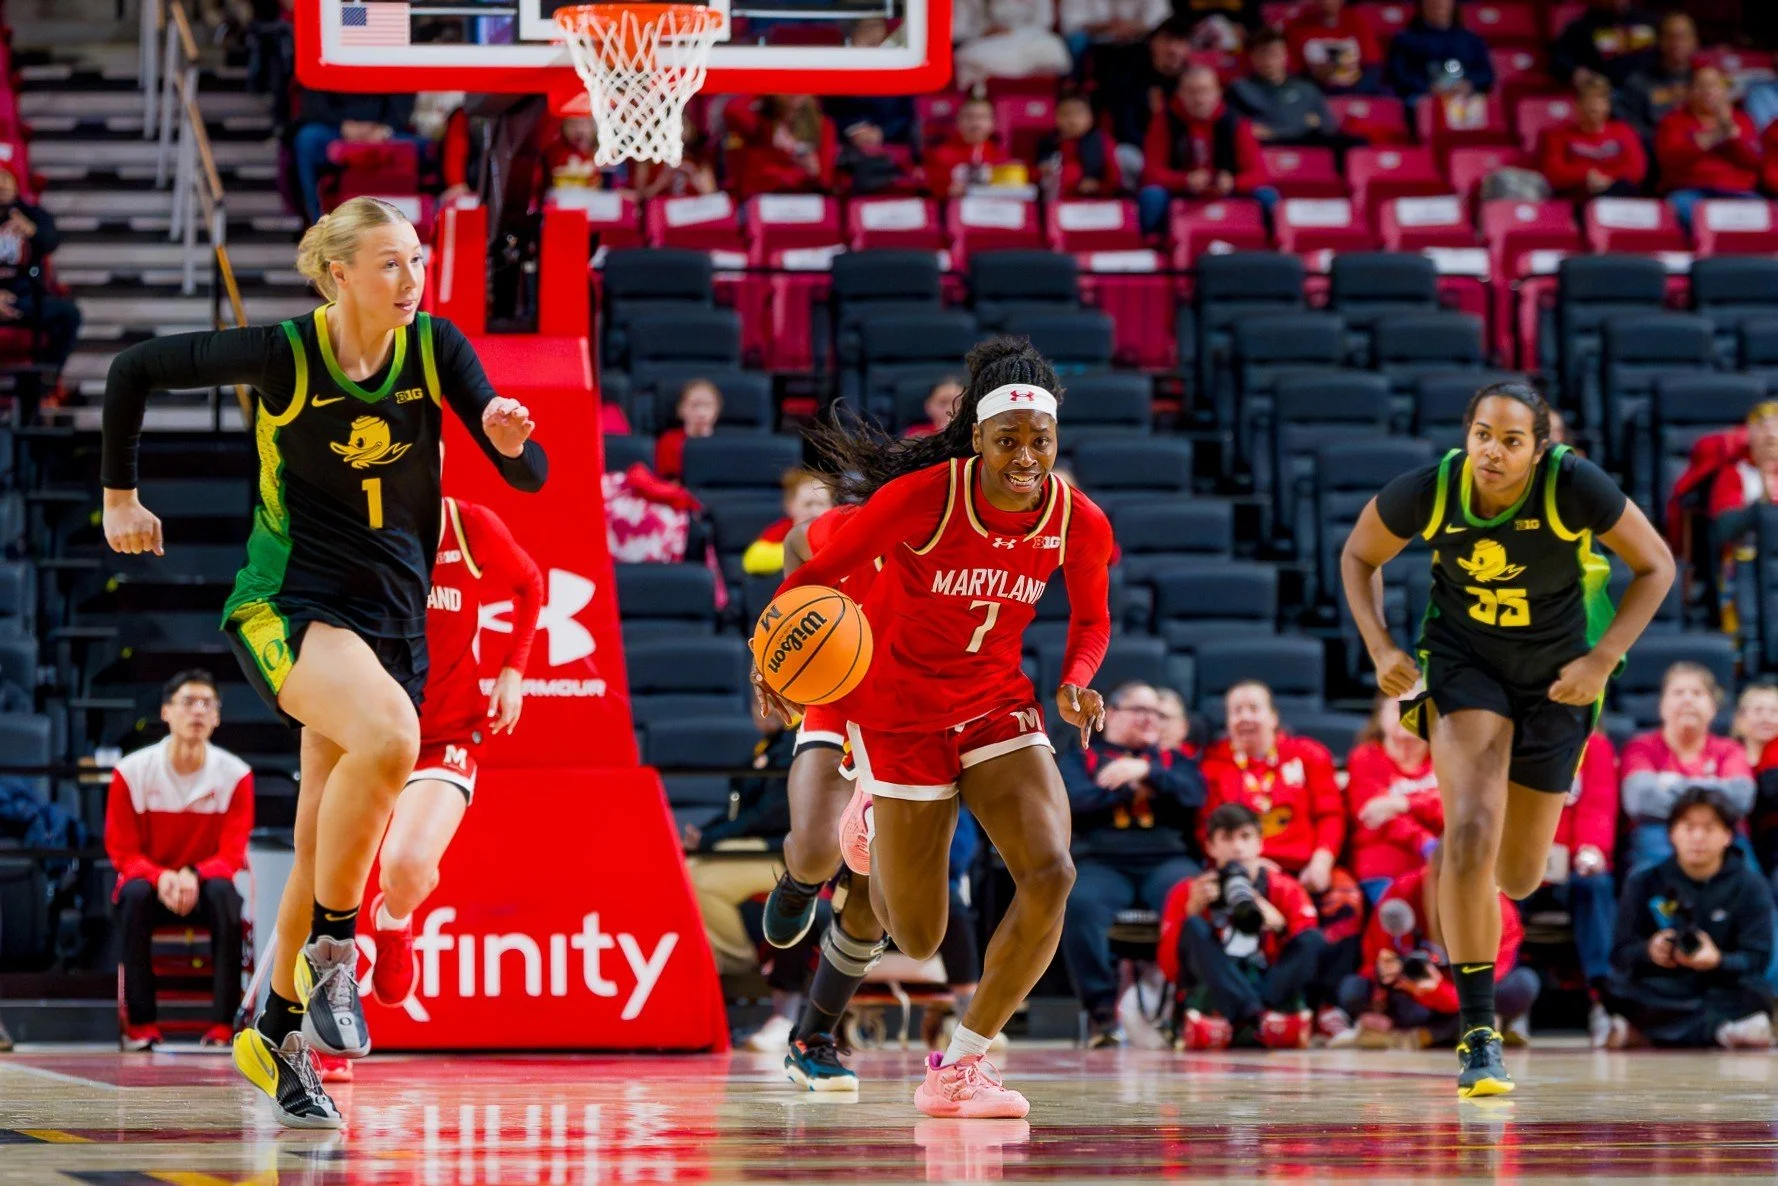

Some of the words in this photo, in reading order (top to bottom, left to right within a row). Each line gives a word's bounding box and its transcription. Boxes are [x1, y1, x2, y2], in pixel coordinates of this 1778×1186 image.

[361, 477, 383, 530] 1
[931, 568, 1046, 605] MARYLAND
[1465, 586, 1531, 627] 35
[767, 610, 828, 674] Wilson
[965, 599, 1001, 653] 7
[1009, 707, 1043, 733] M
[443, 744, 468, 771] M
